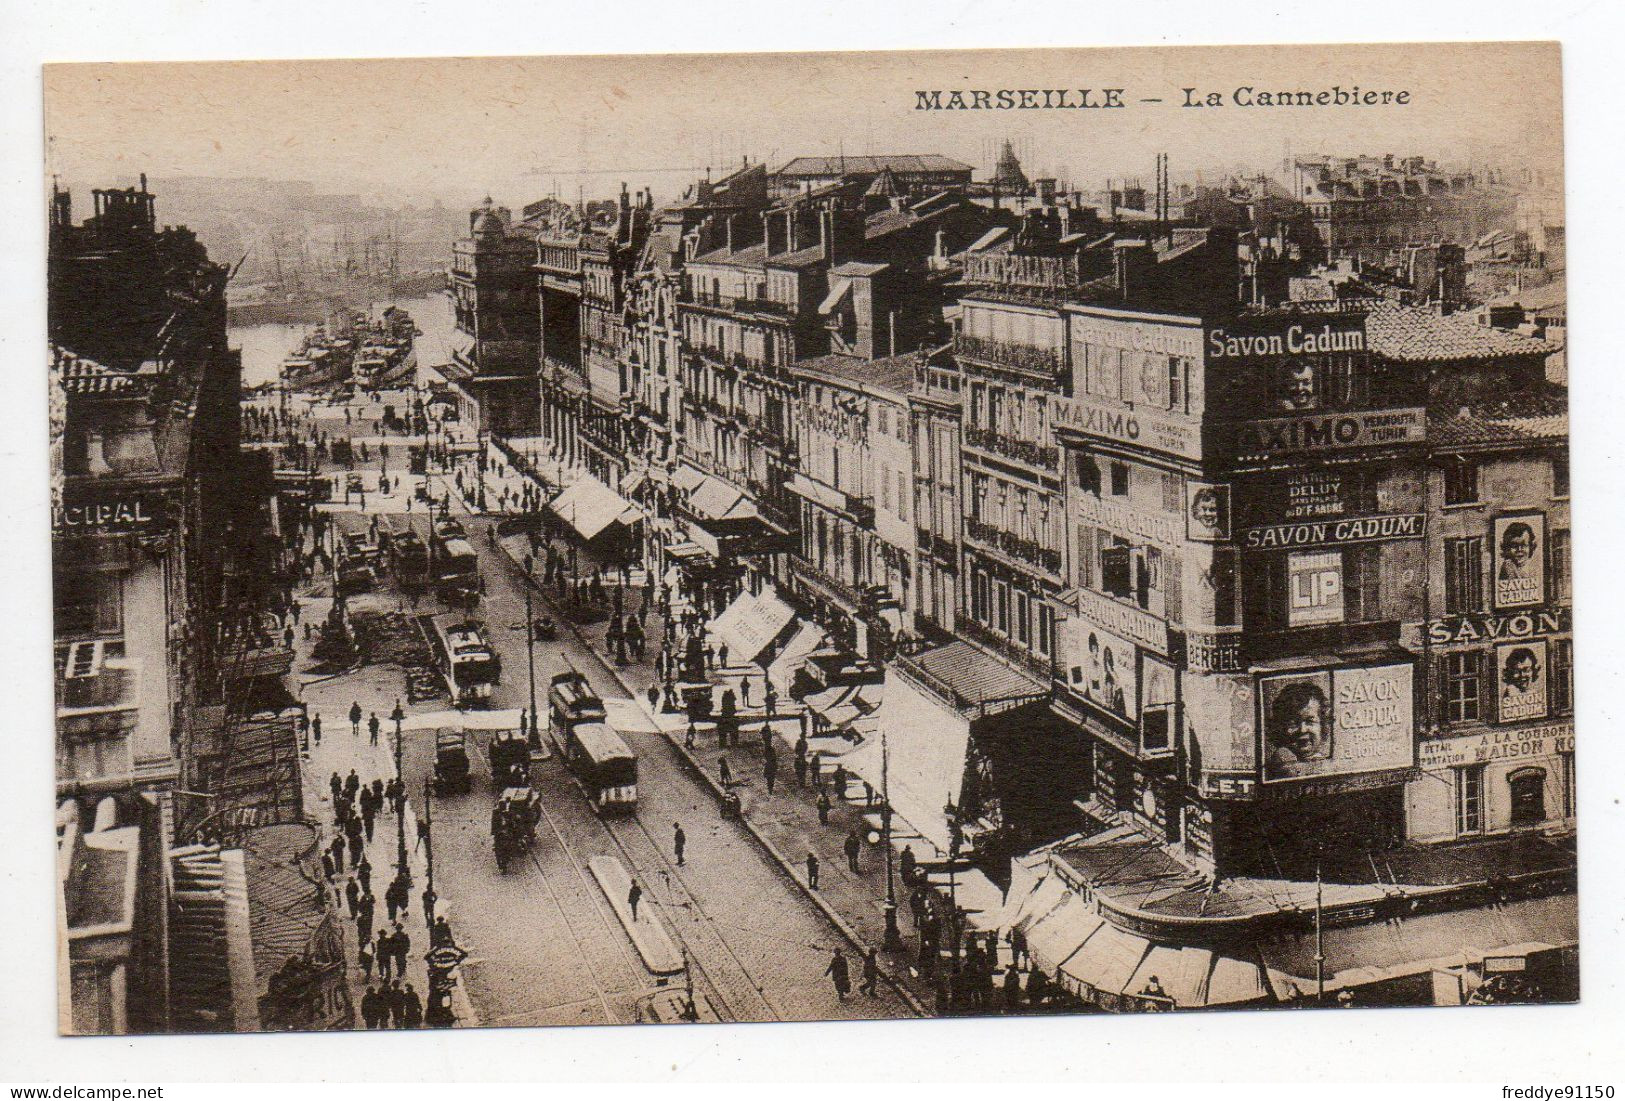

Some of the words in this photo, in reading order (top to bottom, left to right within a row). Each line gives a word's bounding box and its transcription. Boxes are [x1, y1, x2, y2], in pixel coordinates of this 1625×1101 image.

[1210, 329, 1283, 357] Savon
[1287, 325, 1363, 353] Cadum
[1054, 400, 1139, 439] MAXIMO
[1290, 483, 1341, 497] DELUY
[1247, 525, 1327, 549] SAVON
[1335, 516, 1416, 541] CADUM
[1292, 571, 1340, 608] LIP
[1500, 578, 1537, 591] SAVON
[1429, 611, 1560, 643] SAVON
[1188, 644, 1242, 671] BERGER
[1339, 680, 1401, 704] SAVON
[1502, 693, 1542, 709] SAVON
[1339, 705, 1401, 730] CADUM
[1475, 738, 1544, 762] MAISON
[1494, 732, 1511, 744] LA
